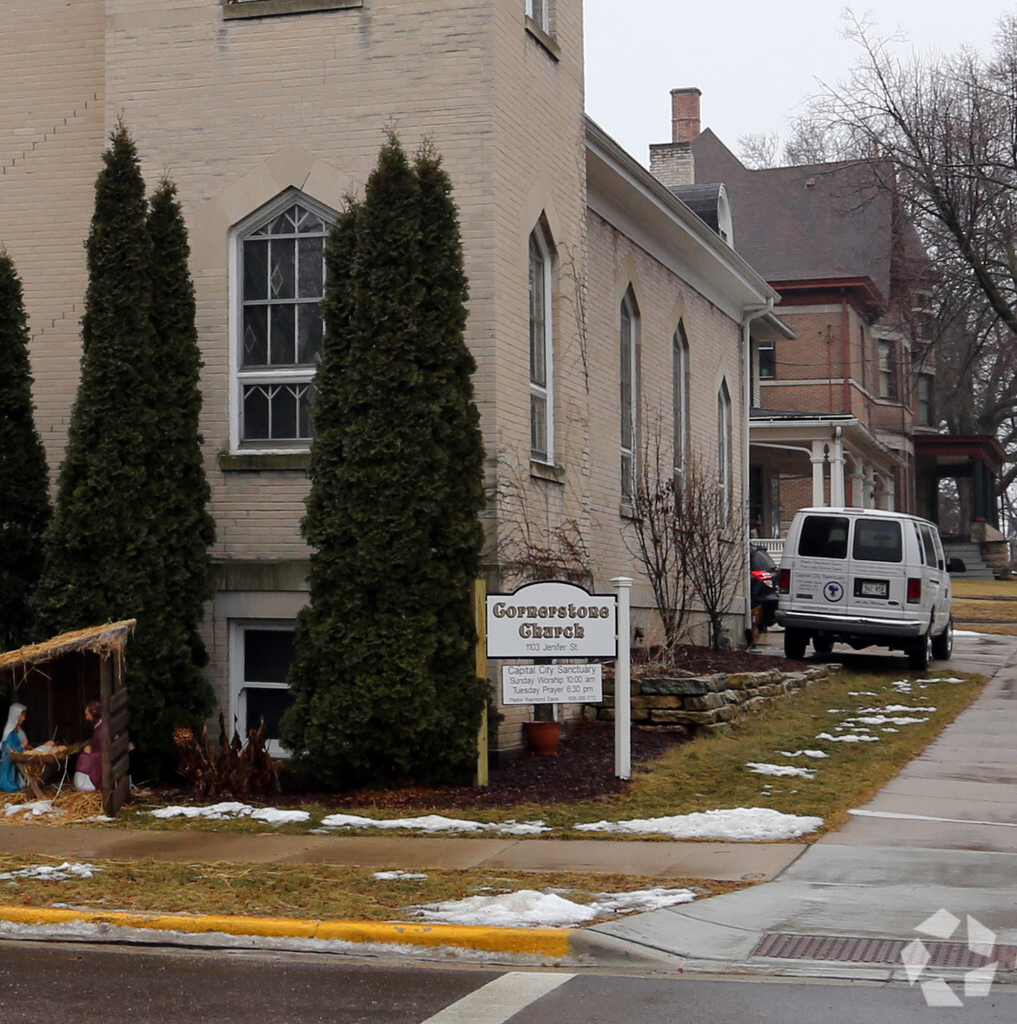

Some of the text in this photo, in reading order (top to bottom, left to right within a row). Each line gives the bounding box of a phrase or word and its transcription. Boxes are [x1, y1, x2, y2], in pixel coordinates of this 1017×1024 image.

[493, 602, 609, 619] Cornerstone
[518, 623, 585, 639] Church
[526, 643, 540, 651] 1103
[543, 643, 566, 651] Jenifer
[508, 665, 596, 676] Capital City Sanctuary
[510, 677, 534, 685] Sunday
[537, 677, 564, 685] Worship
[513, 687, 540, 695] Tuesday
[542, 686, 564, 695] Prayer
